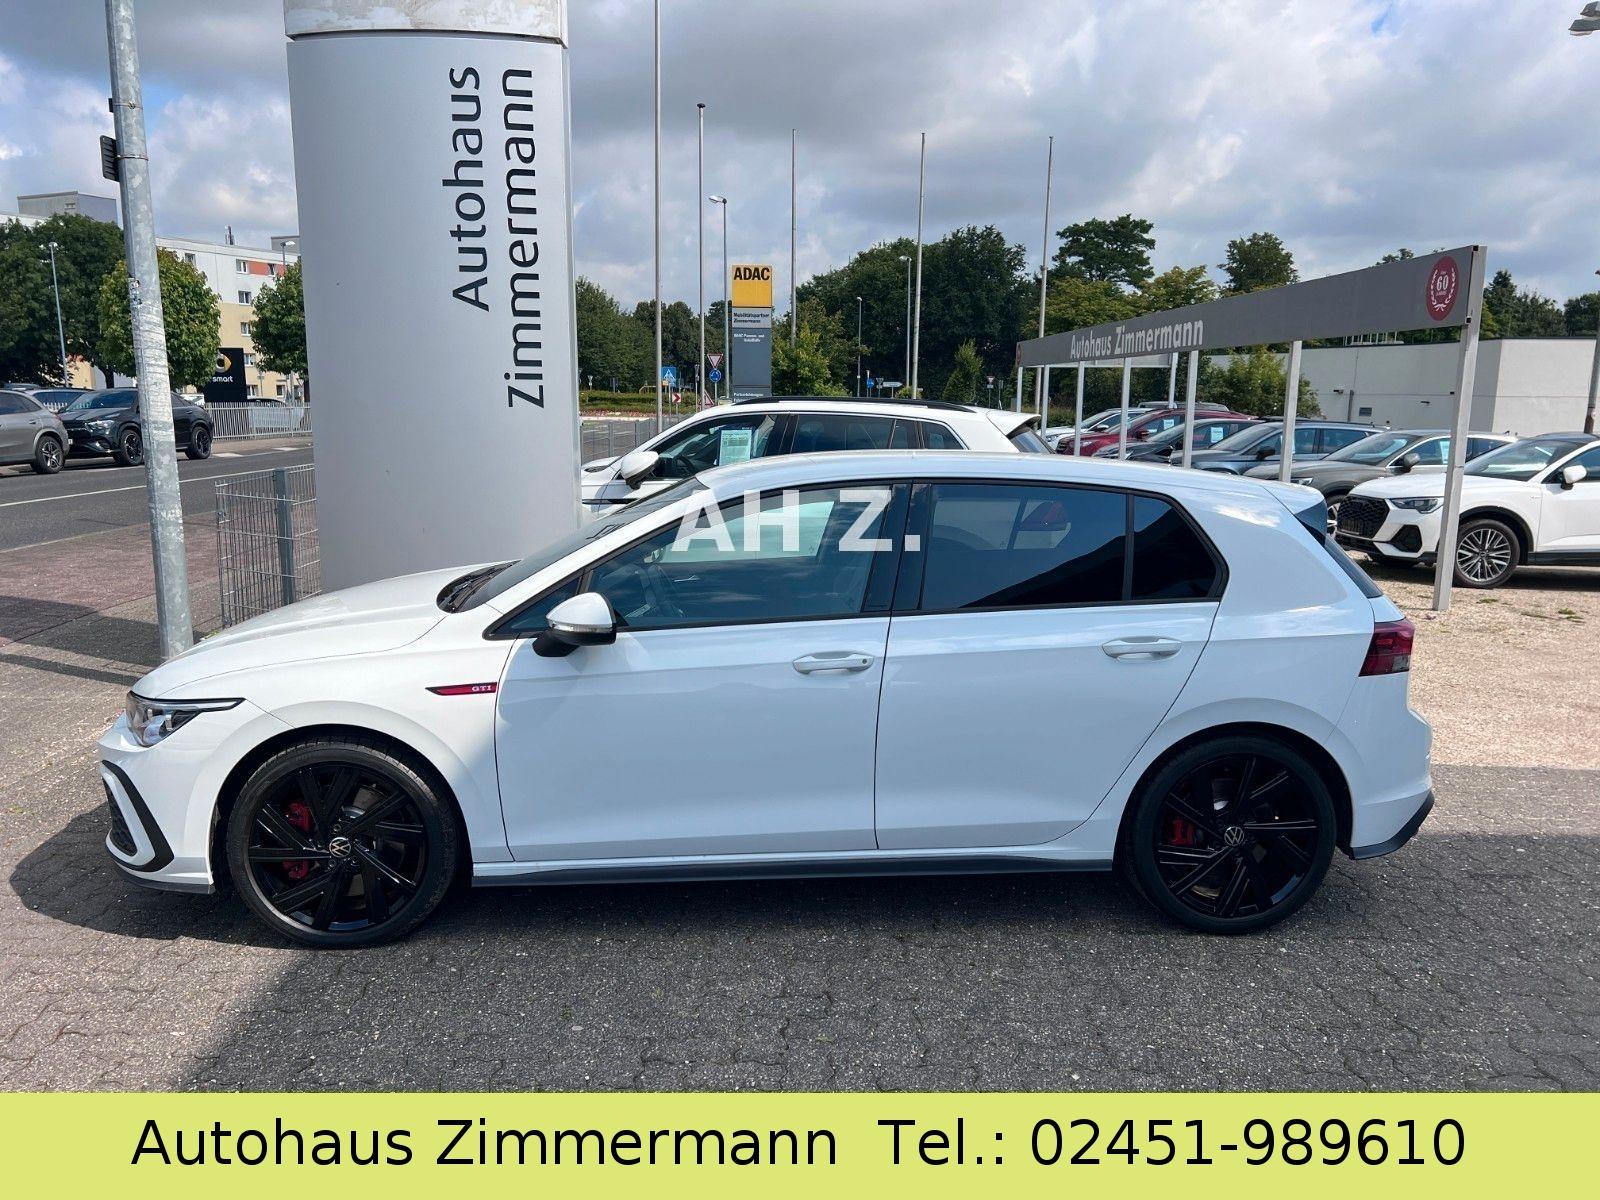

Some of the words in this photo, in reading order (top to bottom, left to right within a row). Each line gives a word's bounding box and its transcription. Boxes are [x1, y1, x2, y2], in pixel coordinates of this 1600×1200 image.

[442, 67, 490, 312] Autohaus
[502, 69, 545, 408] Zimmermann
[734, 267, 770, 281] ADAC
[1436, 275, 1449, 291] 60
[1070, 331, 1112, 359] Autohaus
[1114, 320, 1204, 355] Zimmermann
